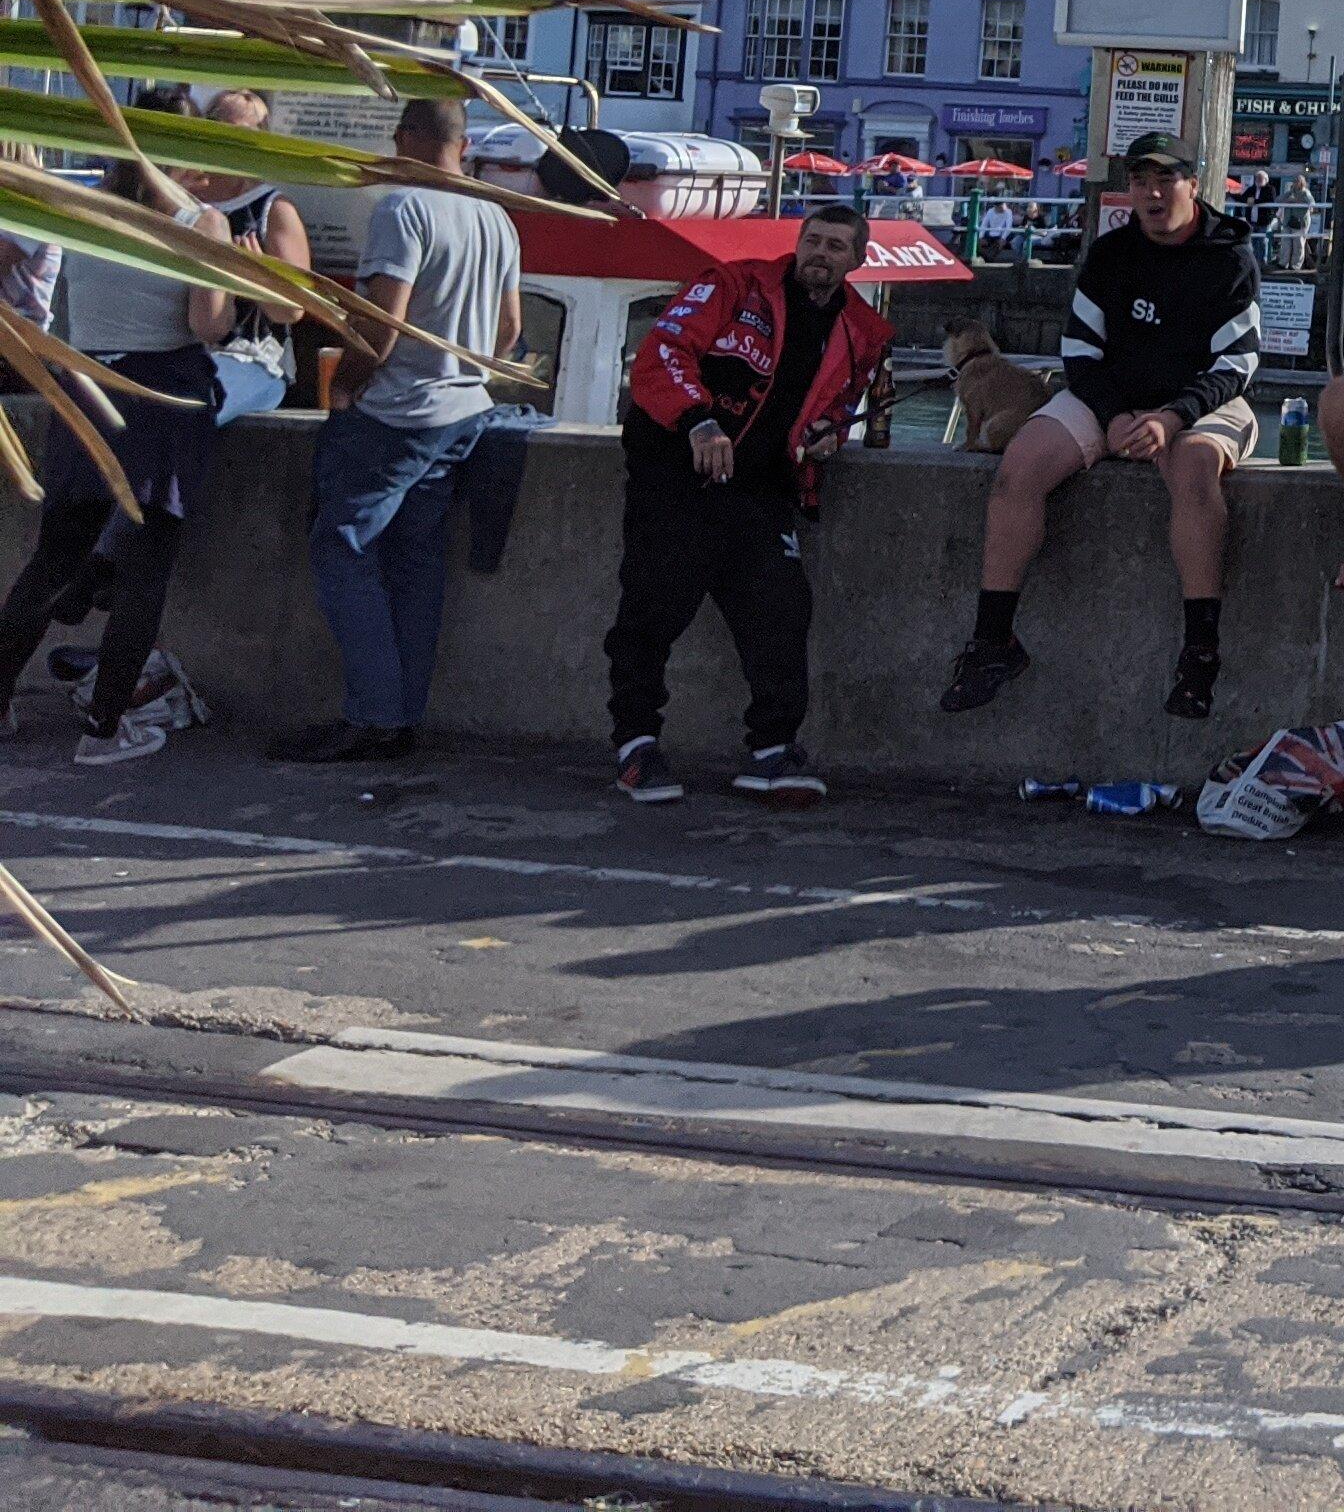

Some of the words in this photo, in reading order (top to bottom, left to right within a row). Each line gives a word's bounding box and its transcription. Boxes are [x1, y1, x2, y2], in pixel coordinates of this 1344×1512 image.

[1141, 61, 1183, 74] WARNING
[1117, 79, 1147, 90] PLEASE
[1148, 81, 1161, 91] DO
[1162, 82, 1179, 93] NOT
[1115, 91, 1135, 101] FEED
[1136, 92, 1152, 103] THE
[1153, 93, 1179, 104] GULLS
[1235, 98, 1276, 113] FISH
[1278, 101, 1292, 115] &
[952, 107, 996, 126] Finishing
[1237, 795, 1263, 813] Great
